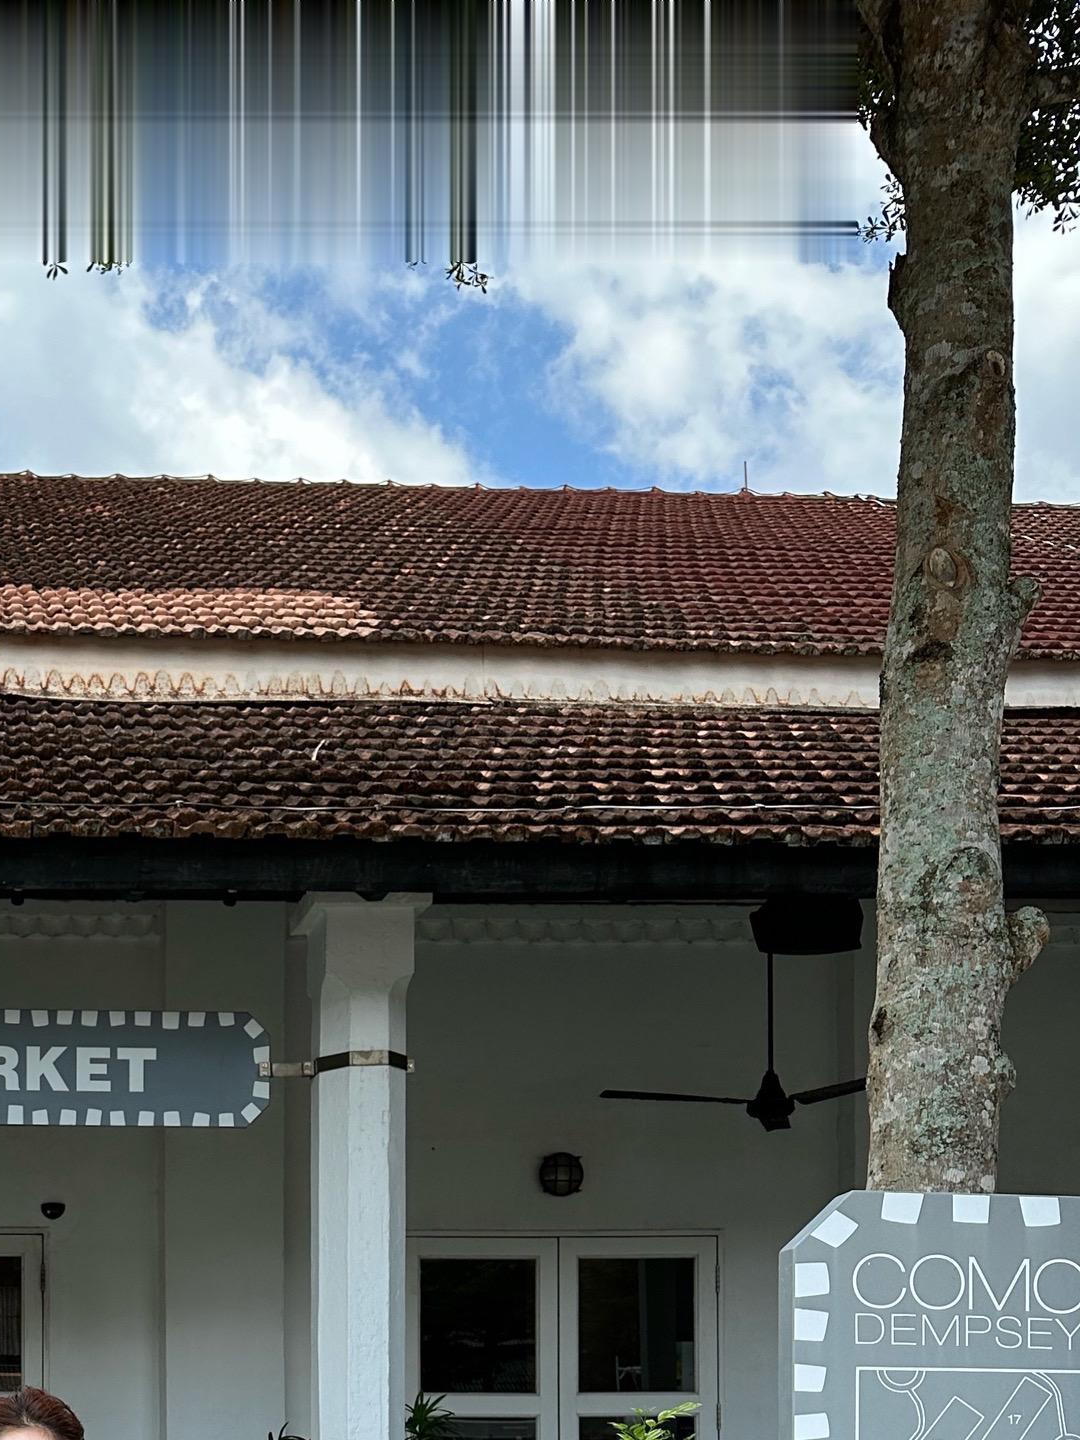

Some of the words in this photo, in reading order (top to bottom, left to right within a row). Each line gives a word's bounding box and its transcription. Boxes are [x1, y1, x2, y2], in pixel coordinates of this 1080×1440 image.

[852, 1253, 1080, 1315] COMO
[854, 1312, 1080, 1351] DEMPSEY
[1008, 1415, 1021, 1424] 17
